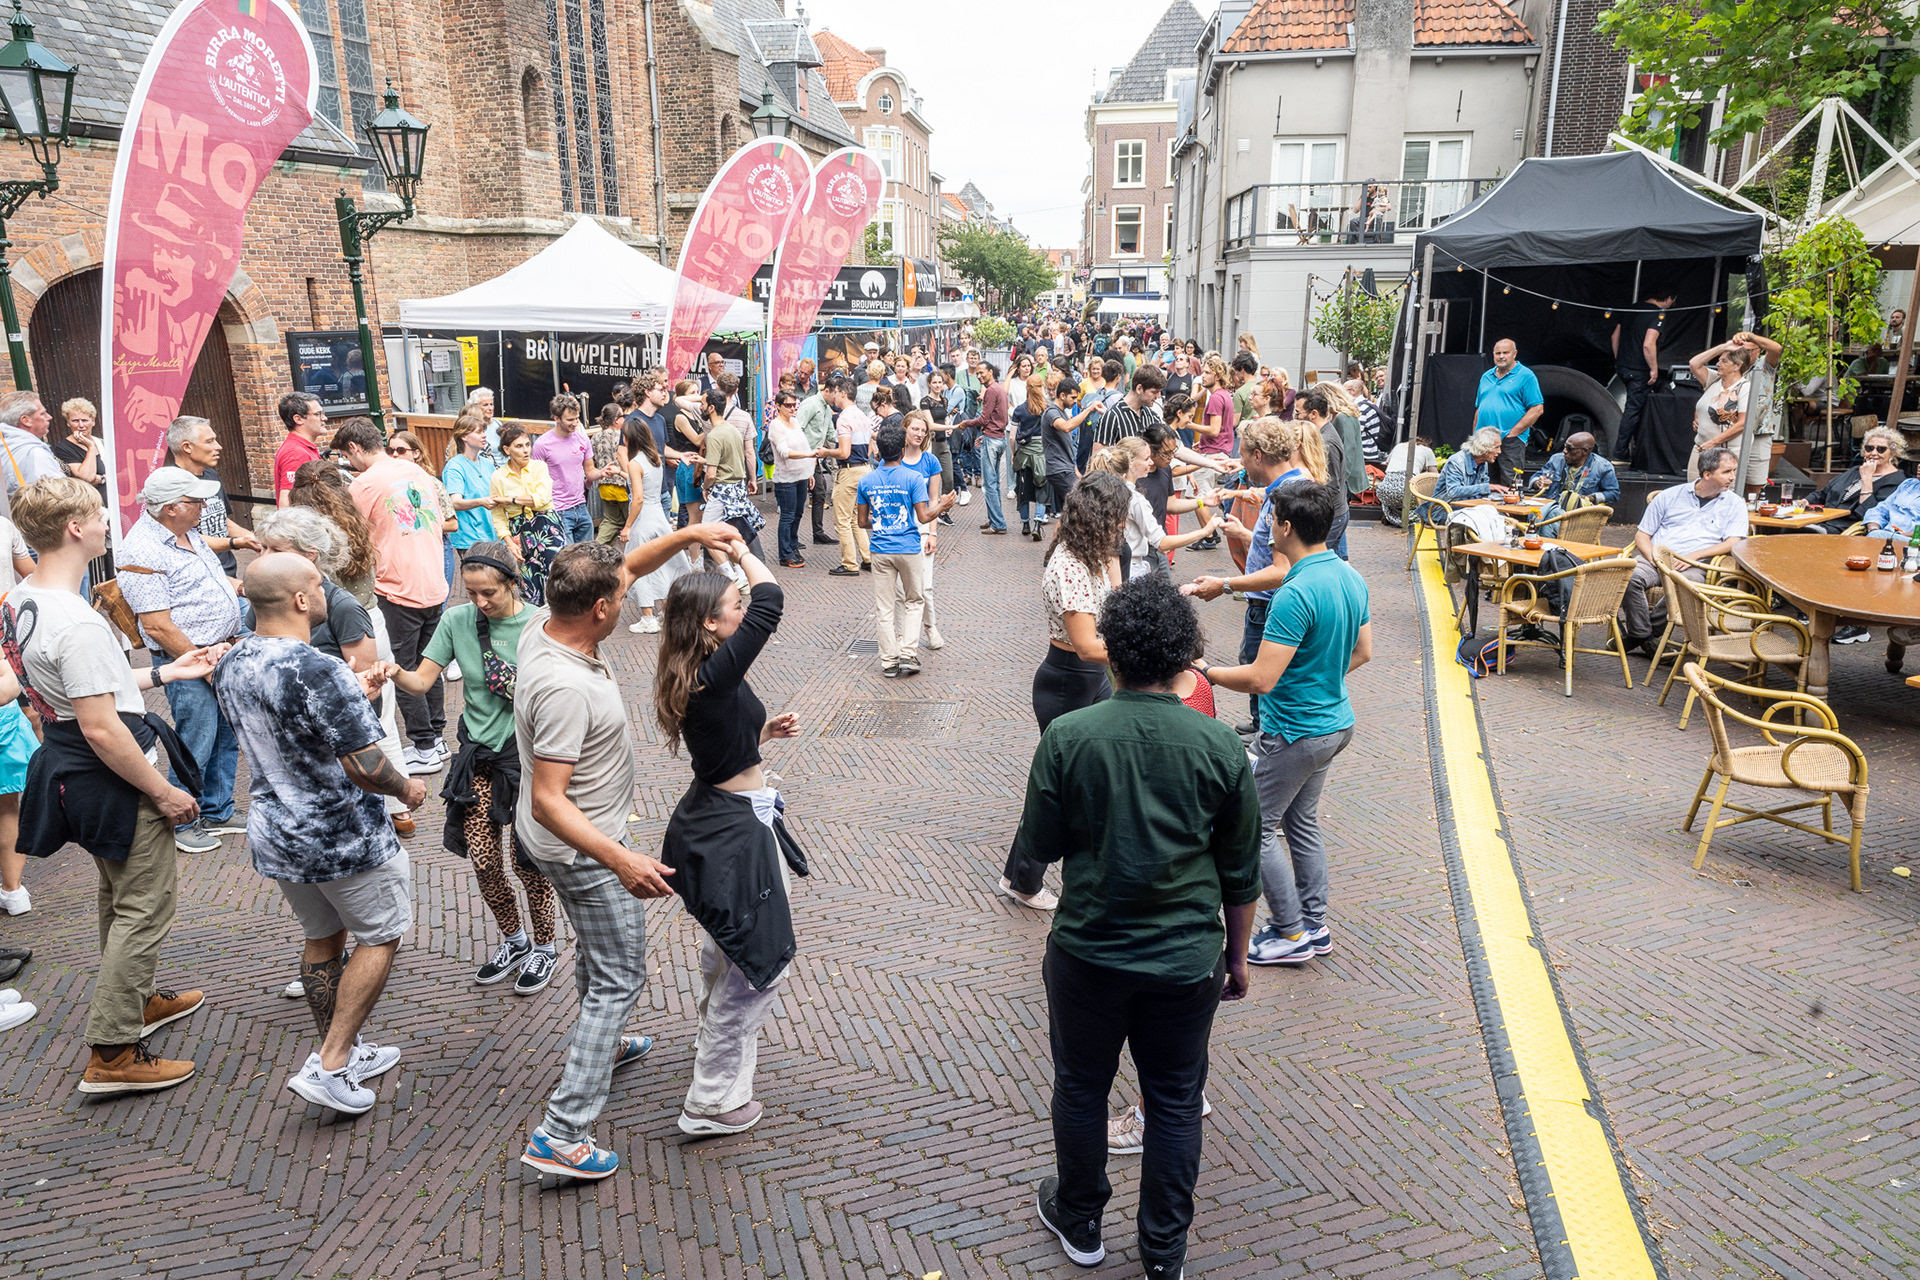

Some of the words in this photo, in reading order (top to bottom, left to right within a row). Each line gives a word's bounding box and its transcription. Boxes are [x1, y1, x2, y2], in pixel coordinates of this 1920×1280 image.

[205, 26, 241, 69] BIRRA
[242, 27, 286, 104] MORETTI
[219, 74, 270, 109] L'AUTENTICA
[138, 98, 257, 210] MO
[747, 163, 771, 185] BIRRA
[772, 163, 794, 204] MORETTI
[753, 188, 784, 207] L'AUTENTICA
[826, 172, 846, 194] BIRRA
[846, 171, 867, 207] MORETTI
[832, 195, 859, 208] L'AUTENTICA
[700, 197, 774, 258] MO
[851, 299, 895, 310] BROUWPLEIN
[112, 353, 142, 375] Luigi
[299, 347, 315, 355] OUDE
[315, 346, 331, 354] KERK
[581, 364, 598, 375] CAFE
[599, 366, 608, 376] DE
[609, 366, 628, 378] OUDE
